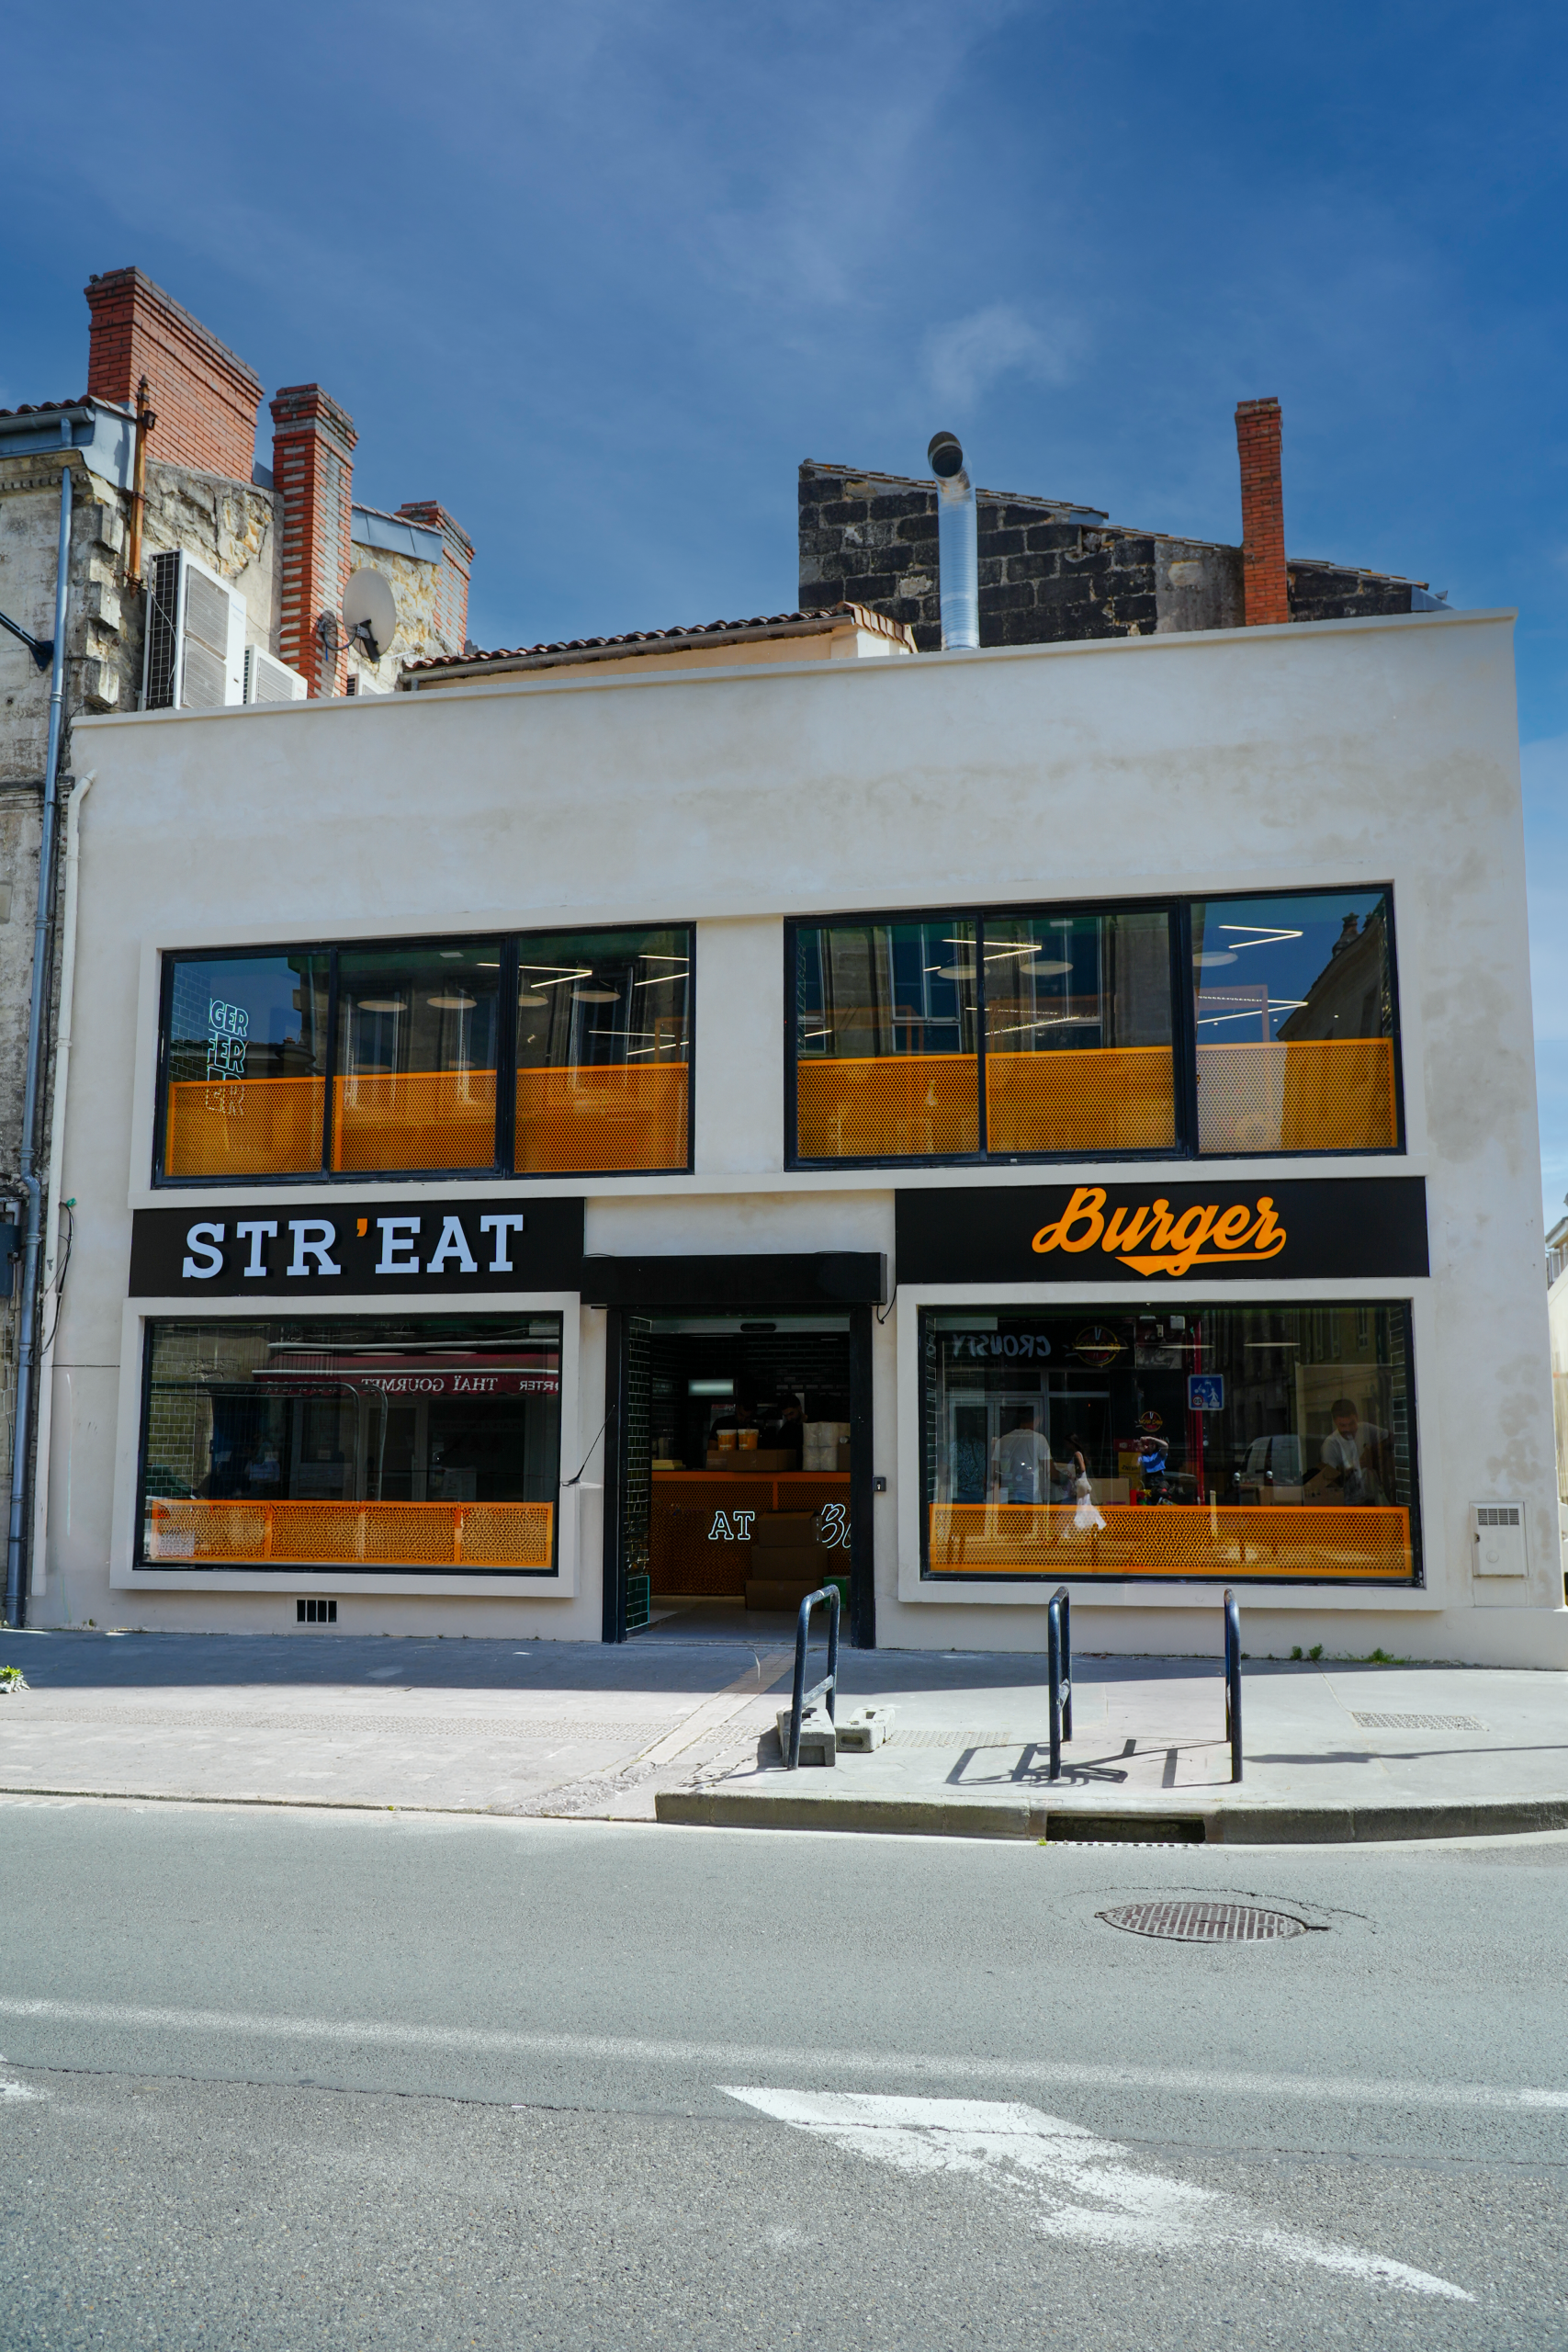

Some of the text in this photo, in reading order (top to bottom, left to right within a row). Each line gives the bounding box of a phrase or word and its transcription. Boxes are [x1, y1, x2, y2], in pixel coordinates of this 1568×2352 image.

[209, 997, 249, 1037] GER
[1031, 1187, 1287, 1277] Burger
[707, 1510, 755, 1542] AT
